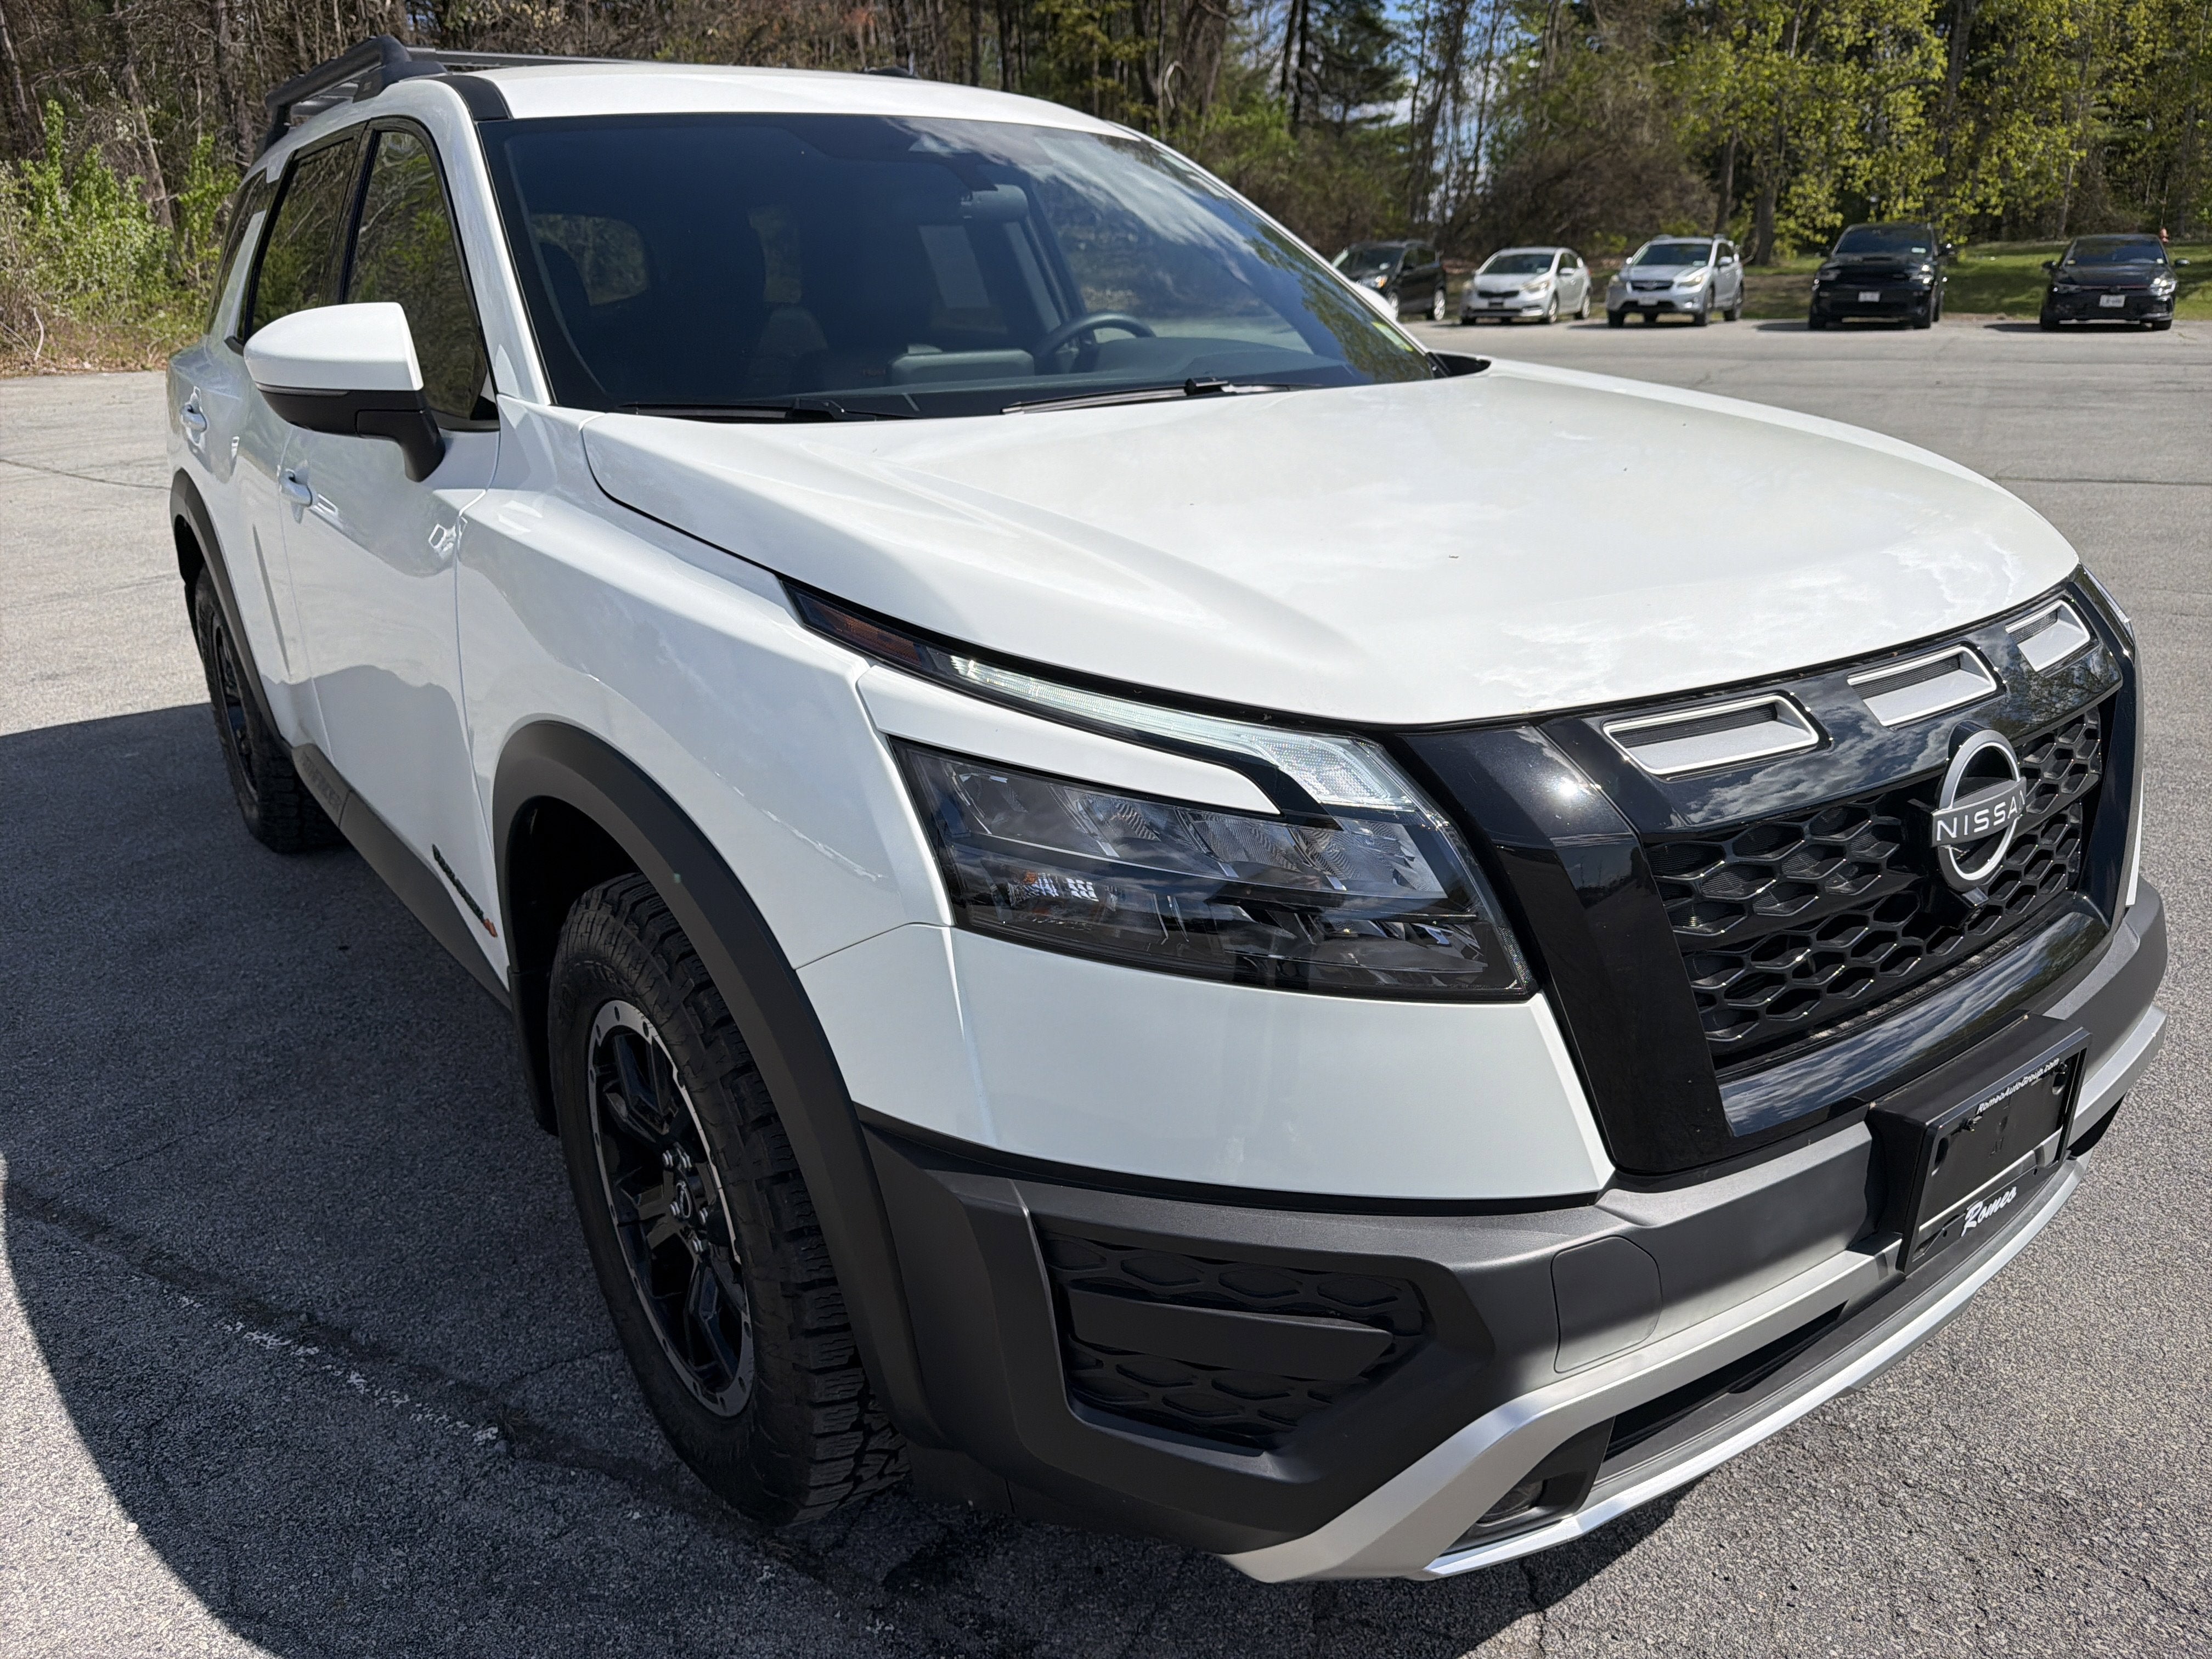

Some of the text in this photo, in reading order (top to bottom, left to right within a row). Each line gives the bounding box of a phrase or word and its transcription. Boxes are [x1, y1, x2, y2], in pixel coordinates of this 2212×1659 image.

[1937, 790, 2025, 841] NISSAN
[1976, 1058, 2060, 1115] RomeoAutoGroup.com
[1961, 1187, 2017, 1237] Romeo
